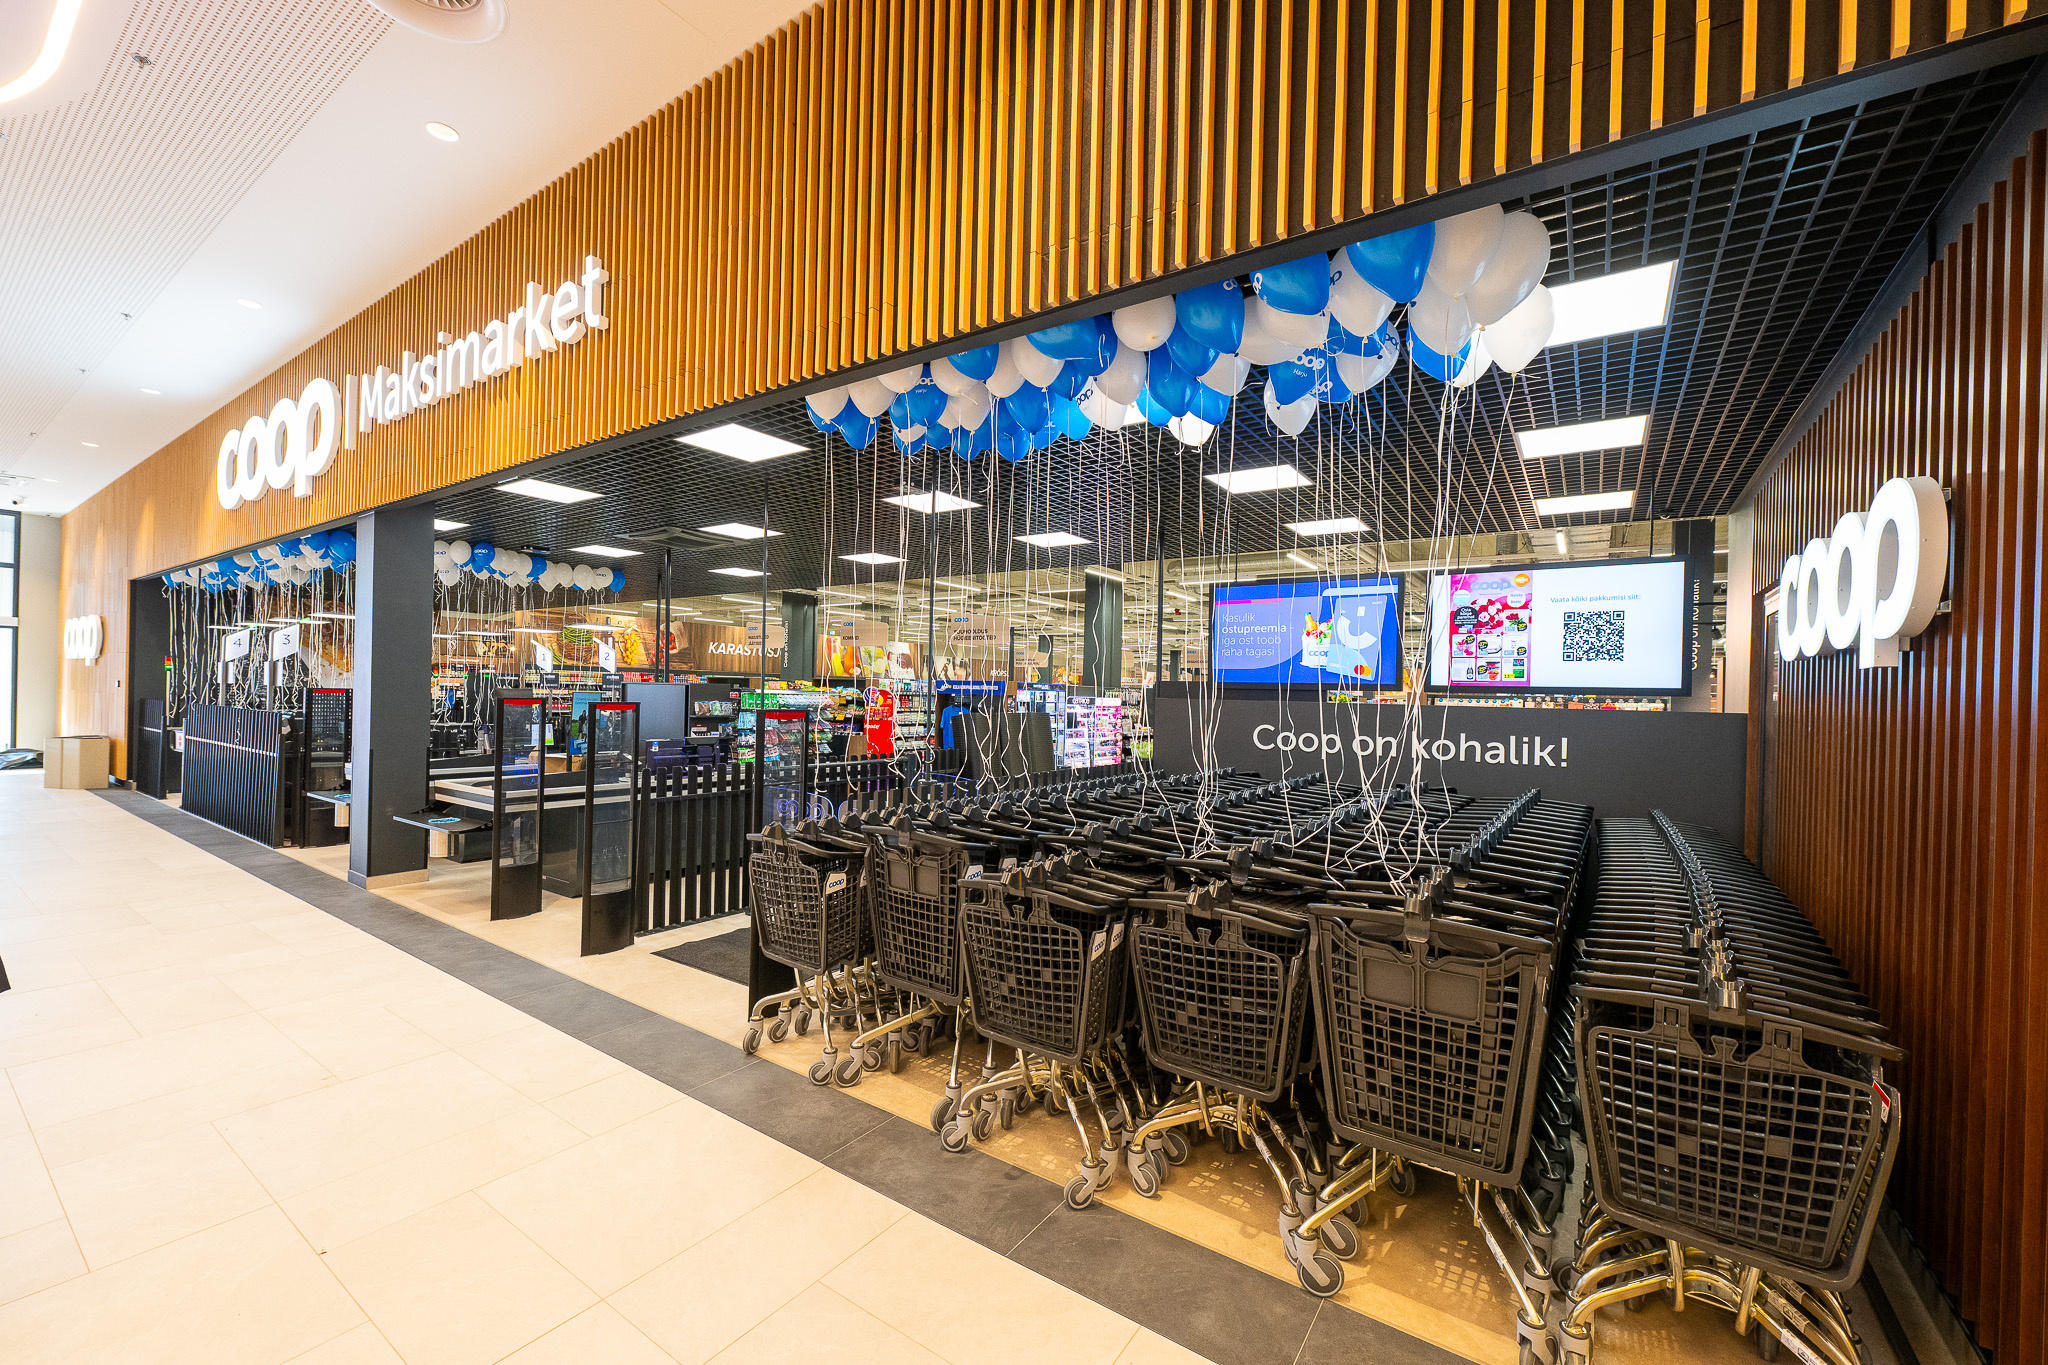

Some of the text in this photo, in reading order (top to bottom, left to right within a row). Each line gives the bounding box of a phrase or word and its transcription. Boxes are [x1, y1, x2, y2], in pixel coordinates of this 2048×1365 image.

[1288, 354, 1325, 370] oop
[216, 254, 609, 510] coop Maksimarket
[1778, 476, 1945, 669] coop
[1470, 580, 1511, 591] coop
[1589, 594, 1626, 603] pakkumisi
[1222, 613, 1256, 623] Kasulik
[1222, 624, 1287, 635] ostupreemia
[64, 614, 101, 667] coop
[233, 638, 242, 647] 4
[282, 634, 291, 645] 3
[1222, 635, 1282, 646] iga ost toob
[708, 641, 781, 658] KARASTUSJ
[1221, 647, 1275, 659] raha tagasi
[604, 652, 610, 661] 2
[1252, 724, 1568, 768] Coop on kohalik!
[829, 878, 845, 888] coop
[1094, 939, 1105, 953] coop
